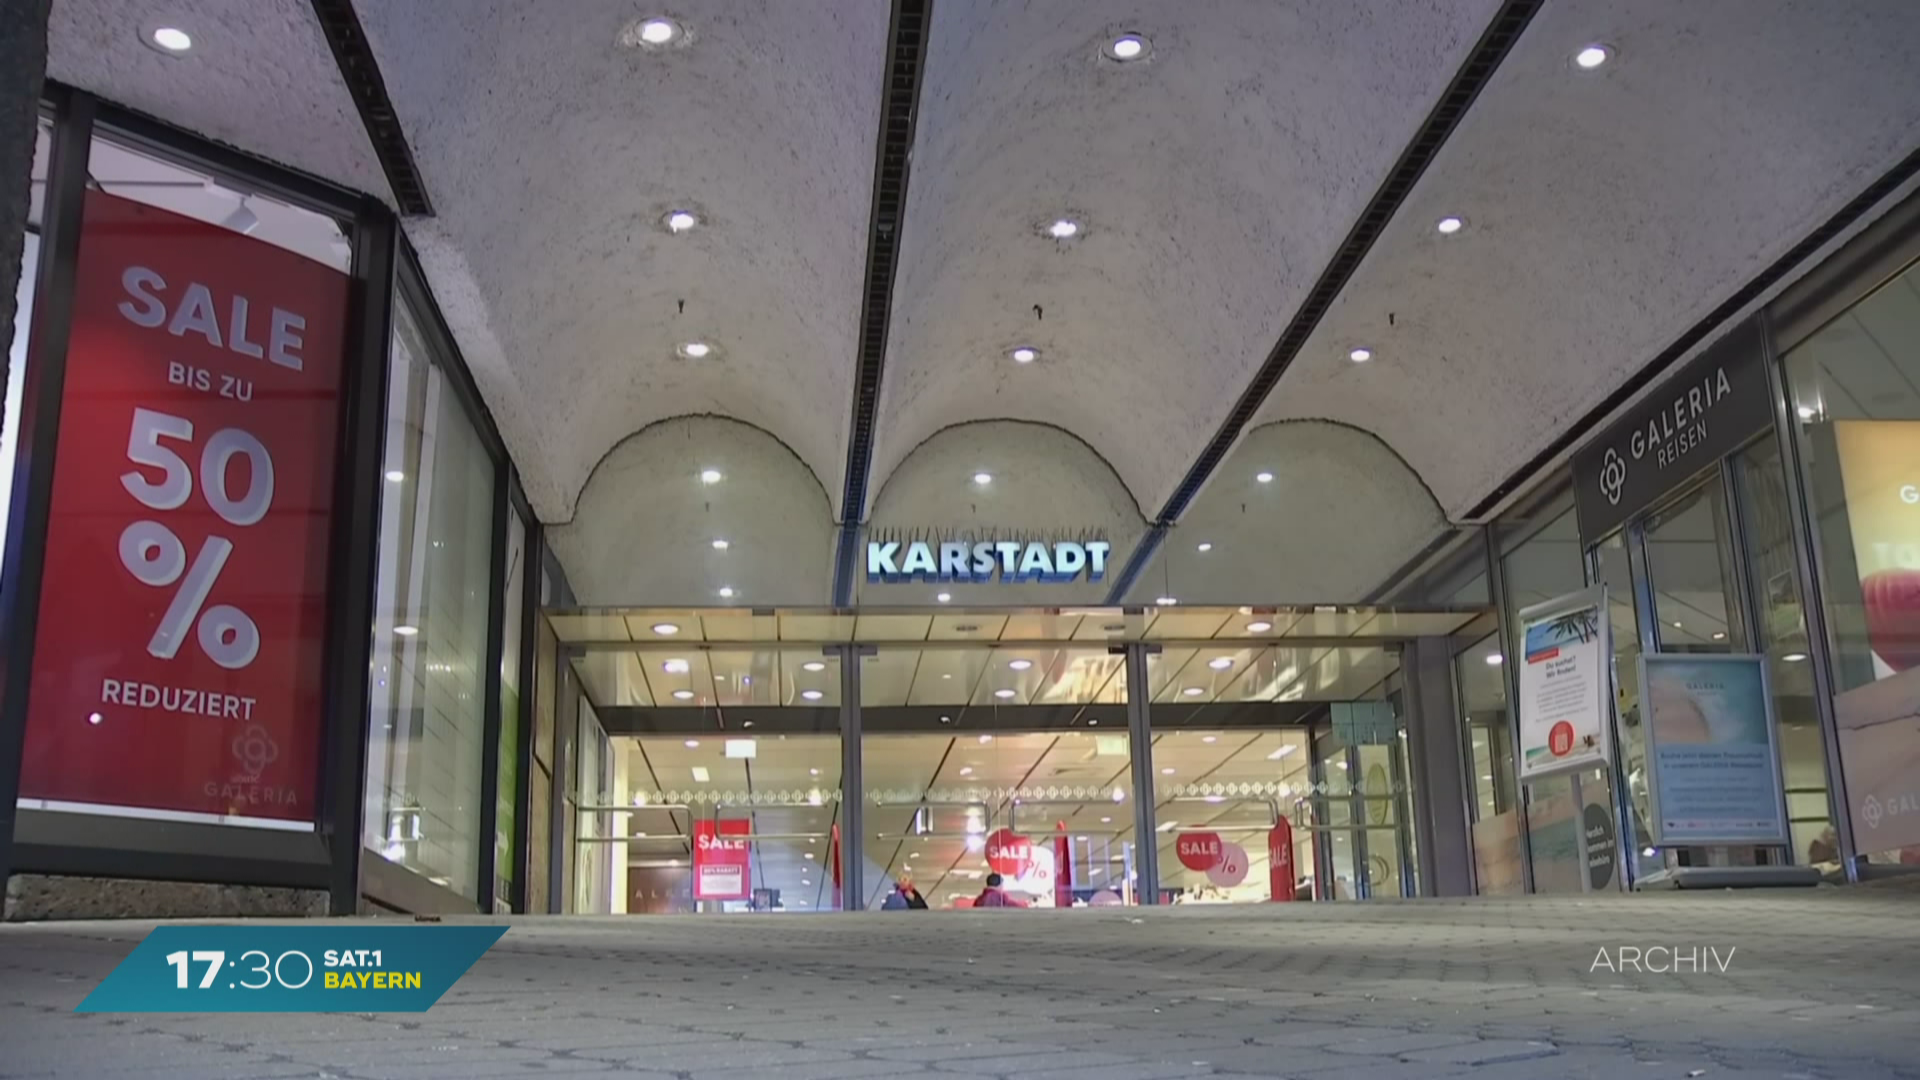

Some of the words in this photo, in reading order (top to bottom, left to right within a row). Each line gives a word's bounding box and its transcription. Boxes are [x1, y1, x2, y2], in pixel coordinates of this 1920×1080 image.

[117, 265, 306, 371] SALE
[168, 361, 210, 391] BIS
[219, 375, 252, 401] ZU
[1631, 367, 1731, 459] GALERIA
[1658, 420, 1707, 470] REISEN
[120, 407, 275, 526] 50
[867, 540, 1109, 580] KARSTADT
[118, 520, 260, 669] %
[101, 679, 256, 720] REDUZIERT
[204, 781, 297, 806] GALERIA
[698, 833, 745, 850] SALE
[990, 845, 1028, 859] SALE
[1180, 841, 1218, 855] SALE
